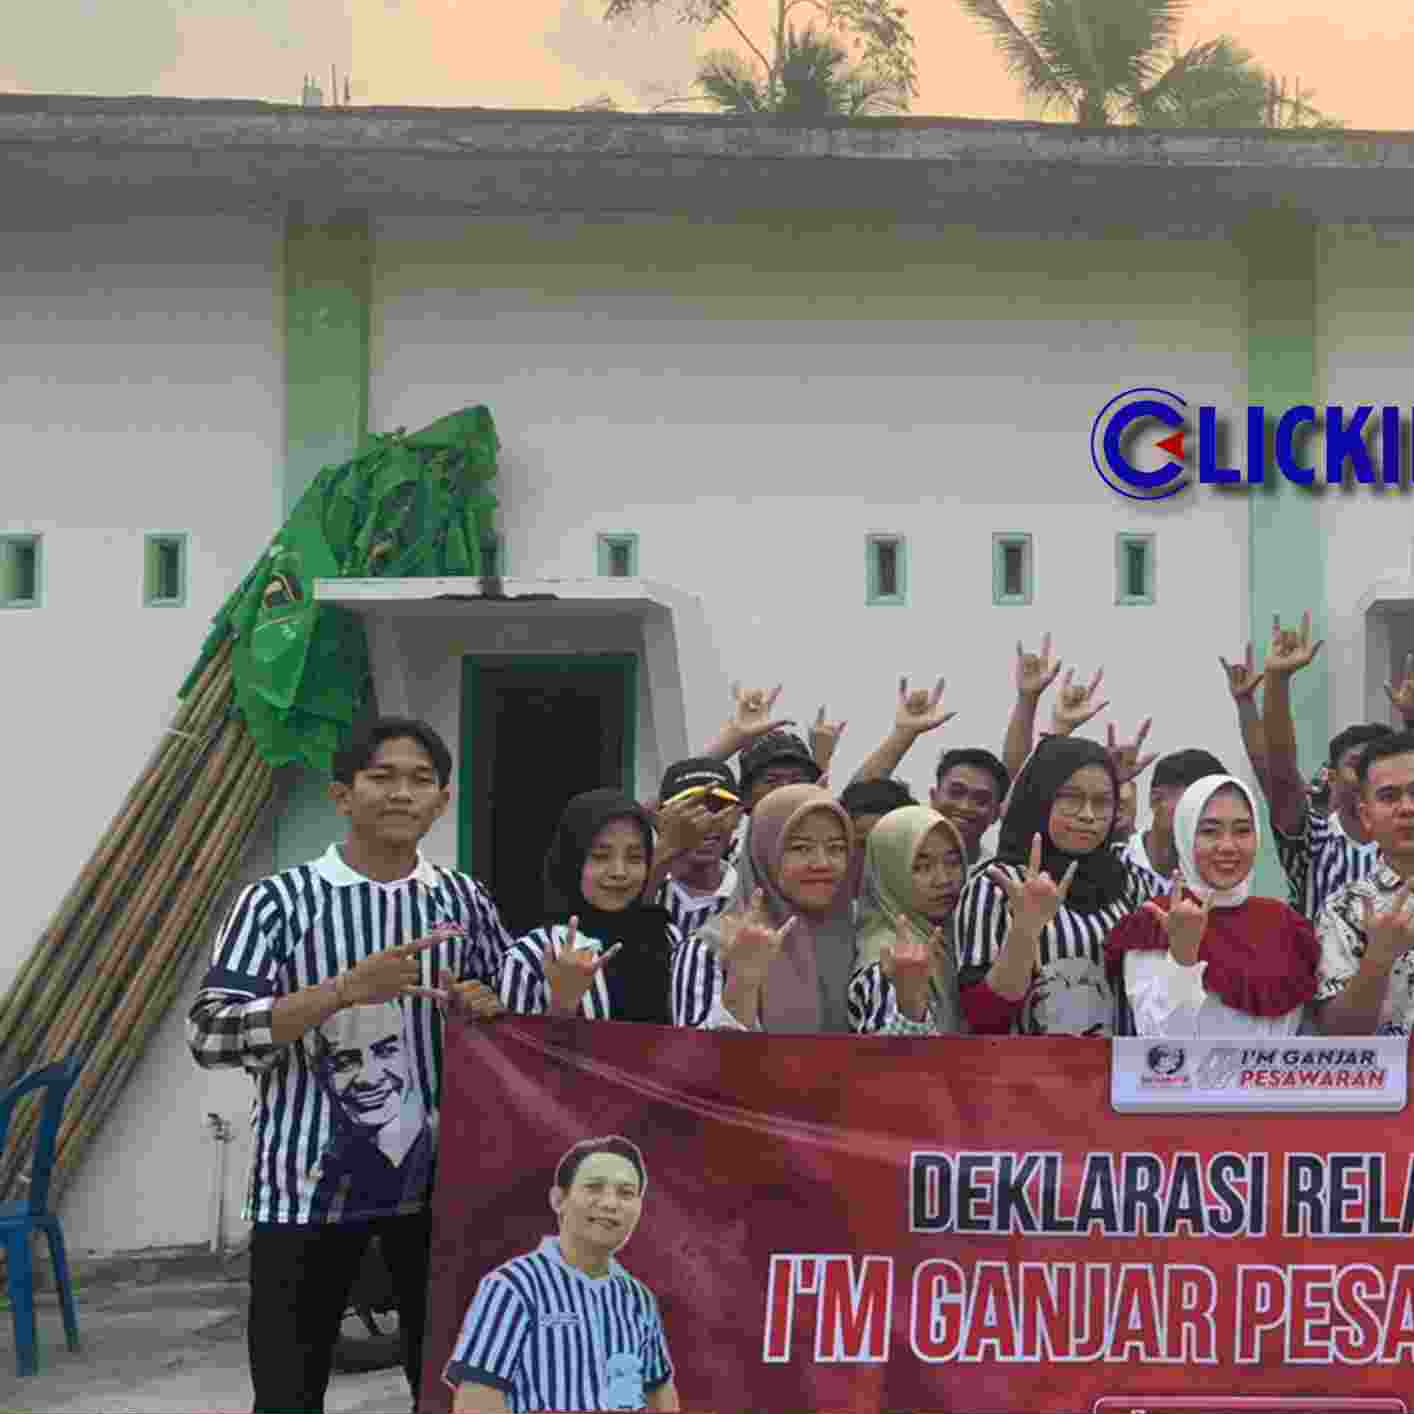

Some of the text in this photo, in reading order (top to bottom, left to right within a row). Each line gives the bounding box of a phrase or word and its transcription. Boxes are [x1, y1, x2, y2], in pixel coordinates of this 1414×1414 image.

[1240, 1049, 1376, 1066] I'M GANJAR
[1240, 1070, 1385, 1088] PESAWARAN
[909, 1150, 1267, 1238] DEKLARASI
[762, 1253, 893, 1363] I'M
[909, 1257, 1219, 1364] GANJAR
